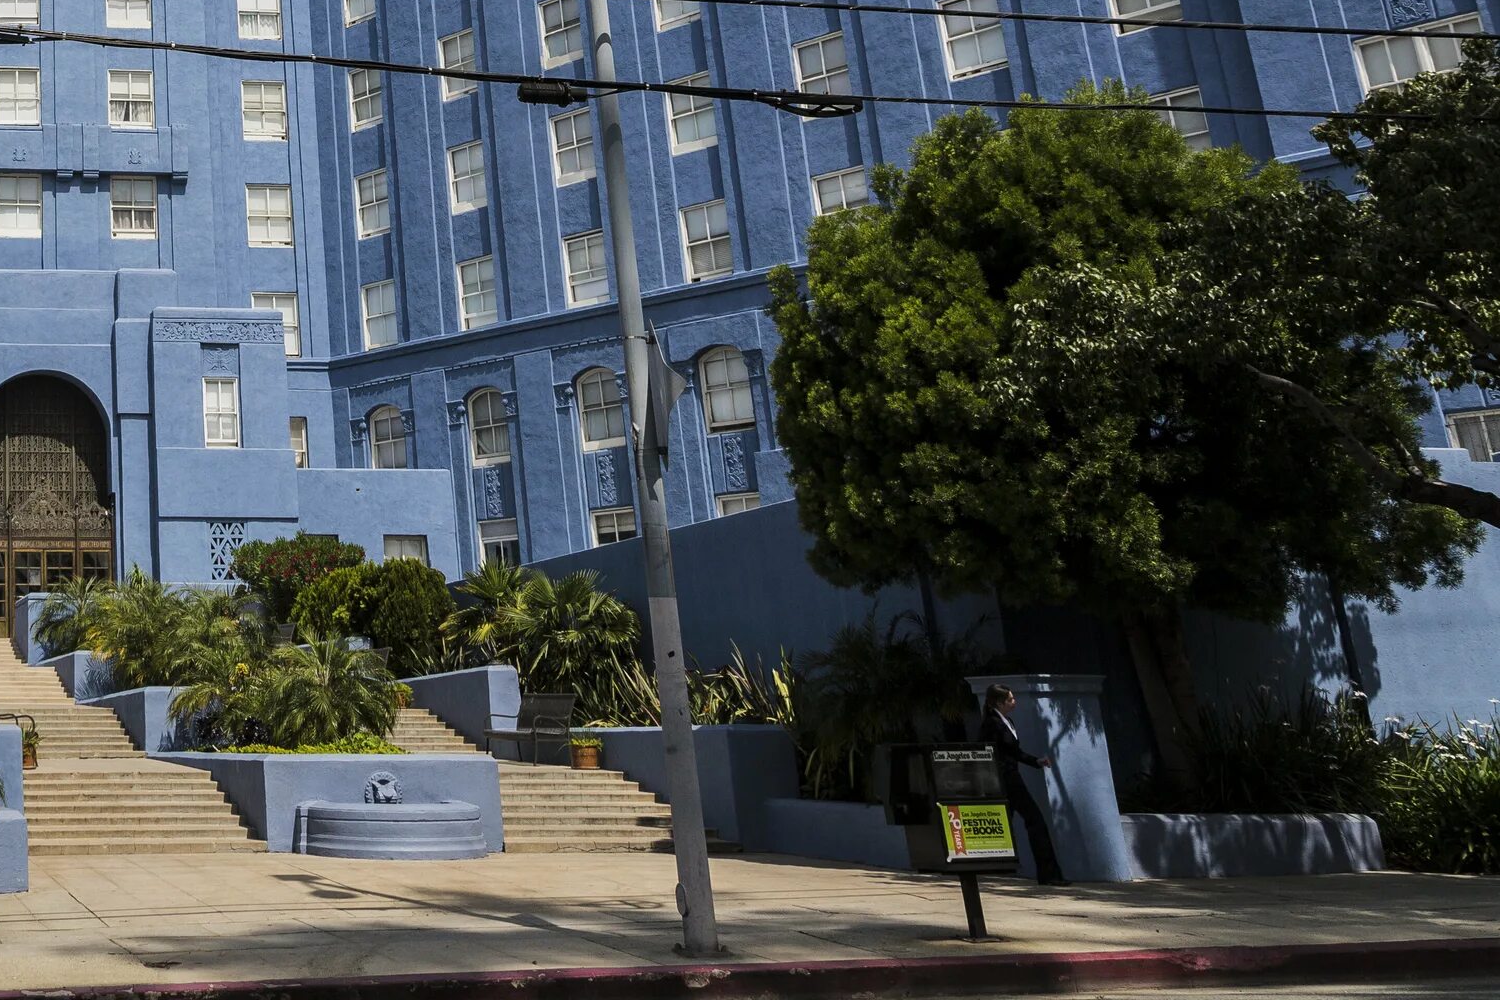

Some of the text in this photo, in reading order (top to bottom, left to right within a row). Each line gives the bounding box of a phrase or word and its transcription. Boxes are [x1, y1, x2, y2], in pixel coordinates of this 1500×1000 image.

[963, 819, 1002, 827] FESTIVAL
[973, 827, 1004, 835] BOOKS
[954, 830, 962, 849] YEARS
